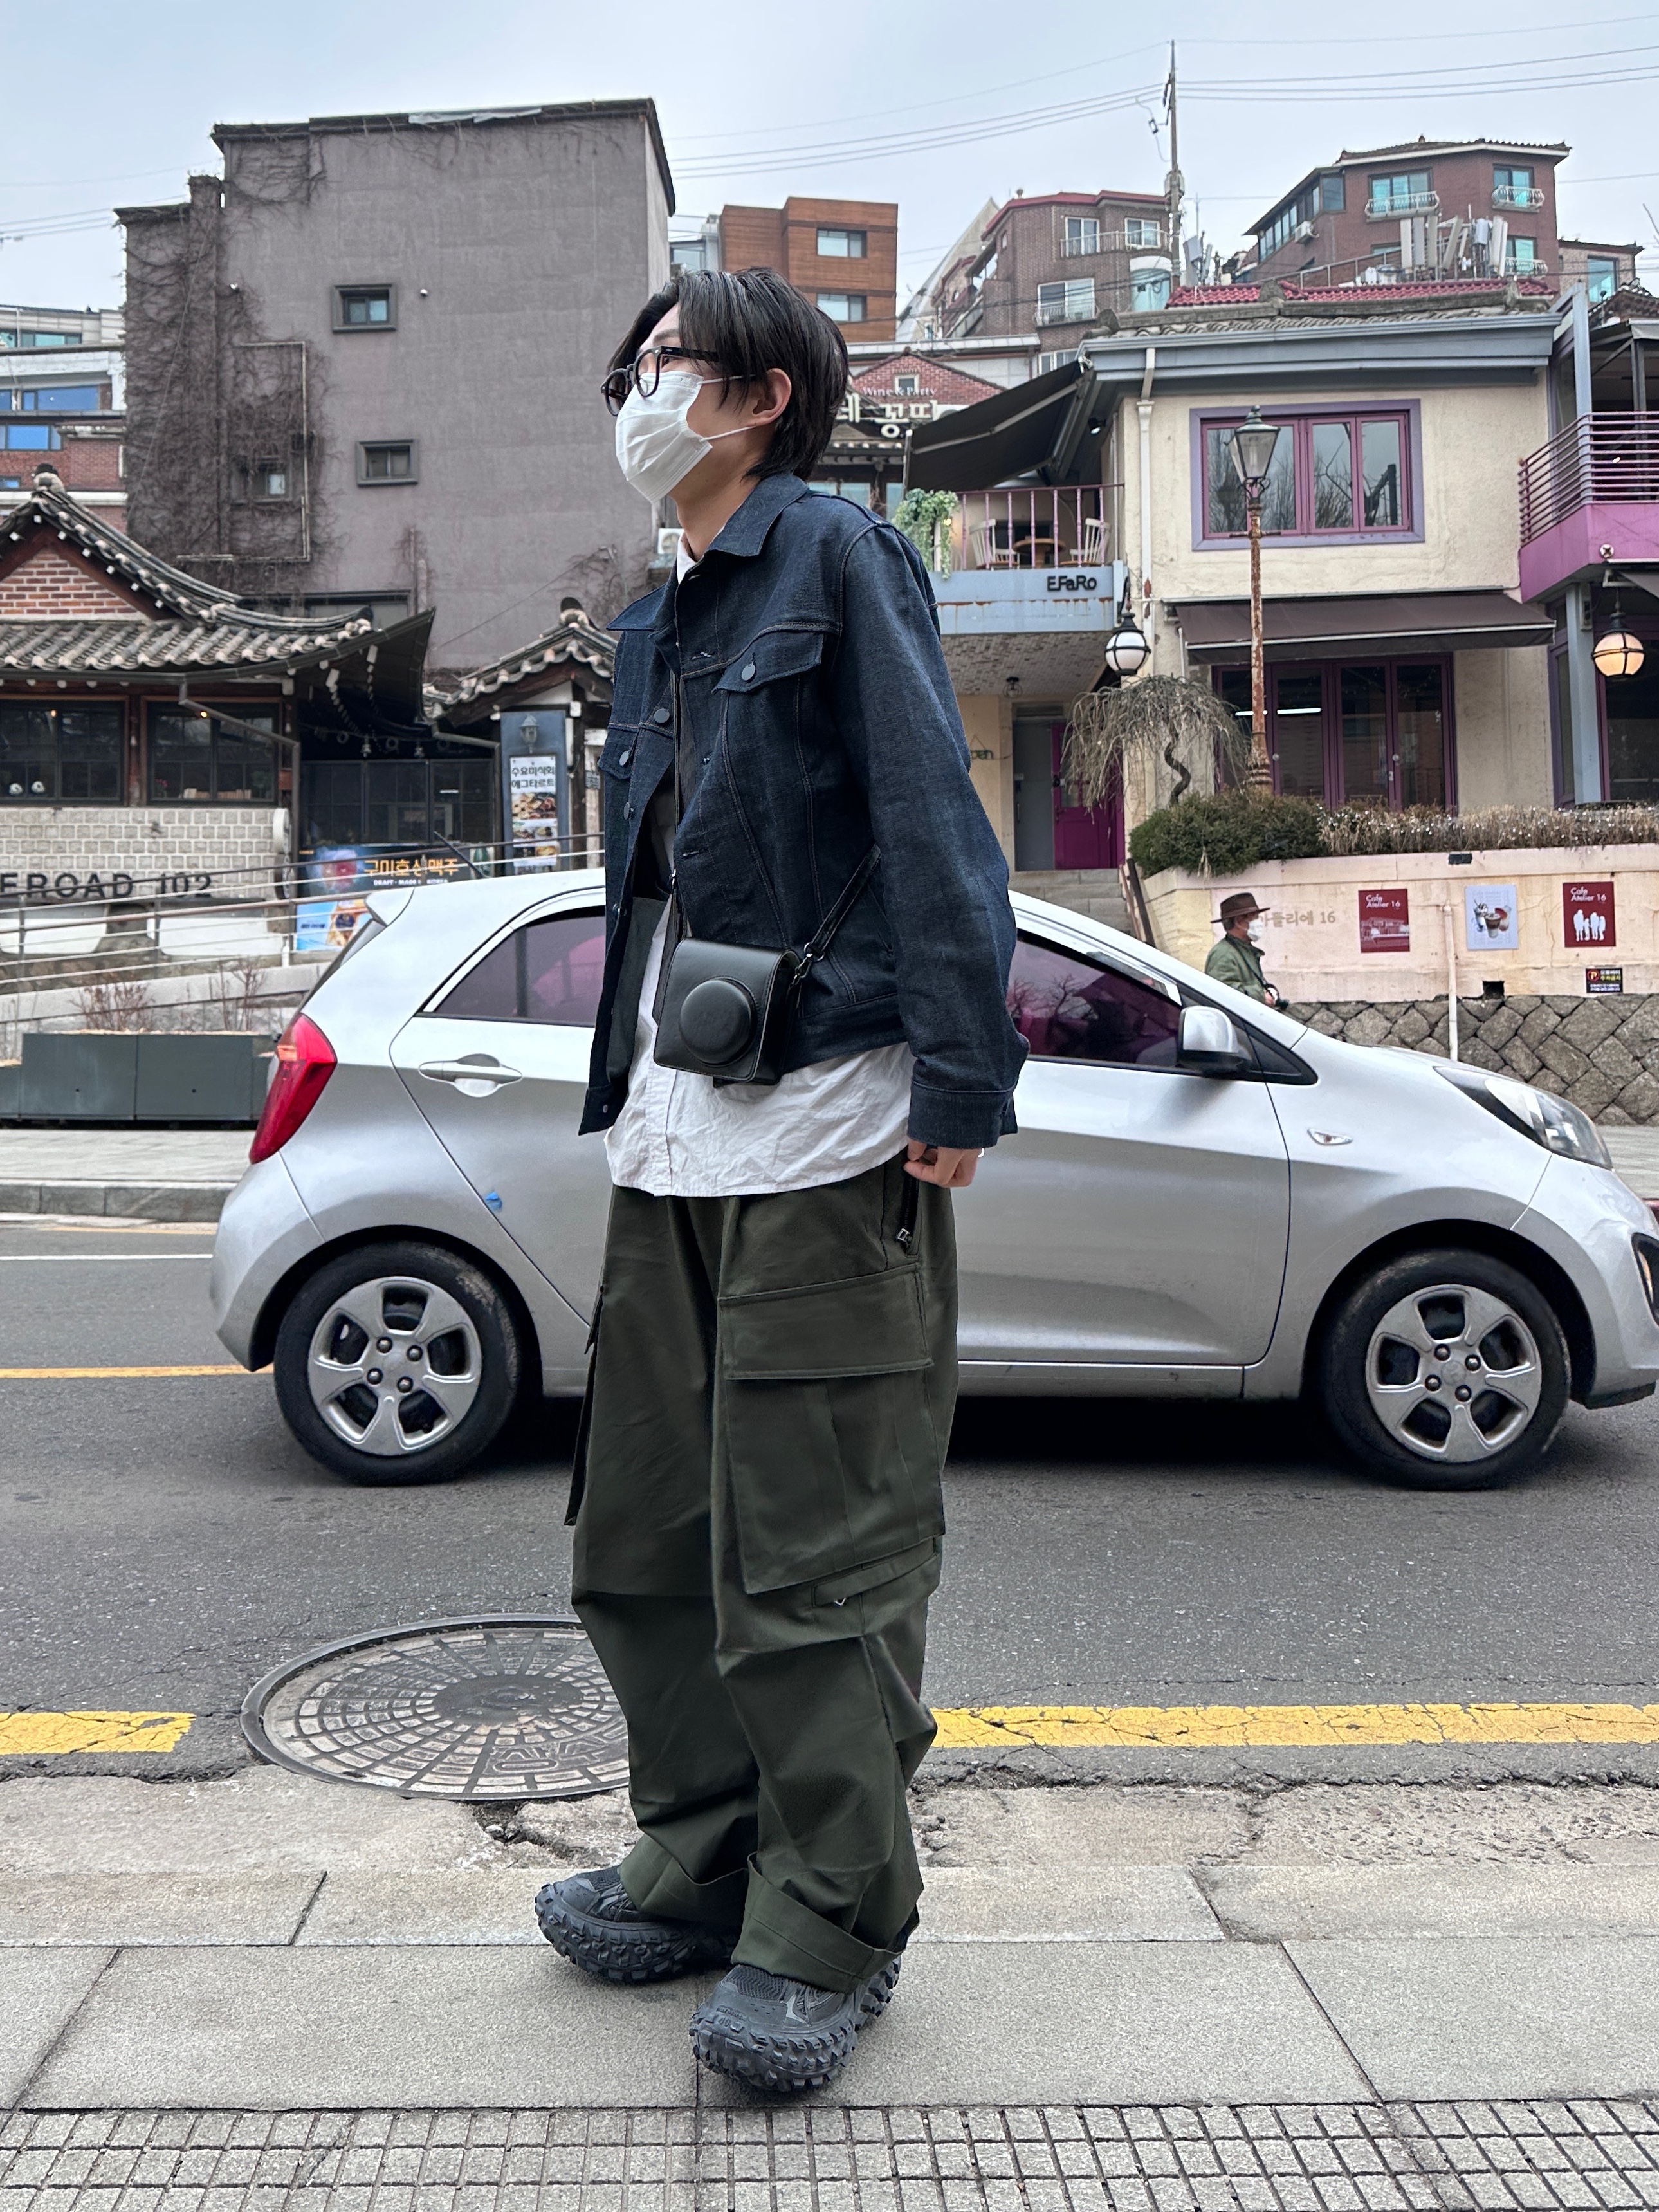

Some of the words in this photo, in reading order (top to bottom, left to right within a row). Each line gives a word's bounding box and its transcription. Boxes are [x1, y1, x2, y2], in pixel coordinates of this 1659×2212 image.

[862, 387, 894, 396] Wine
[906, 387, 938, 398] Party
[1047, 575, 1097, 591] EFaRo
[511, 779, 555, 789] 에그타르트
[364, 859, 410, 876] 구미호
[160, 872, 211, 898] 102
[1570, 887, 1588, 896] Cafe
[1597, 893, 1607, 901] 16
[1366, 894, 1383, 903] Cafe
[1320, 911, 1336, 924] 16
